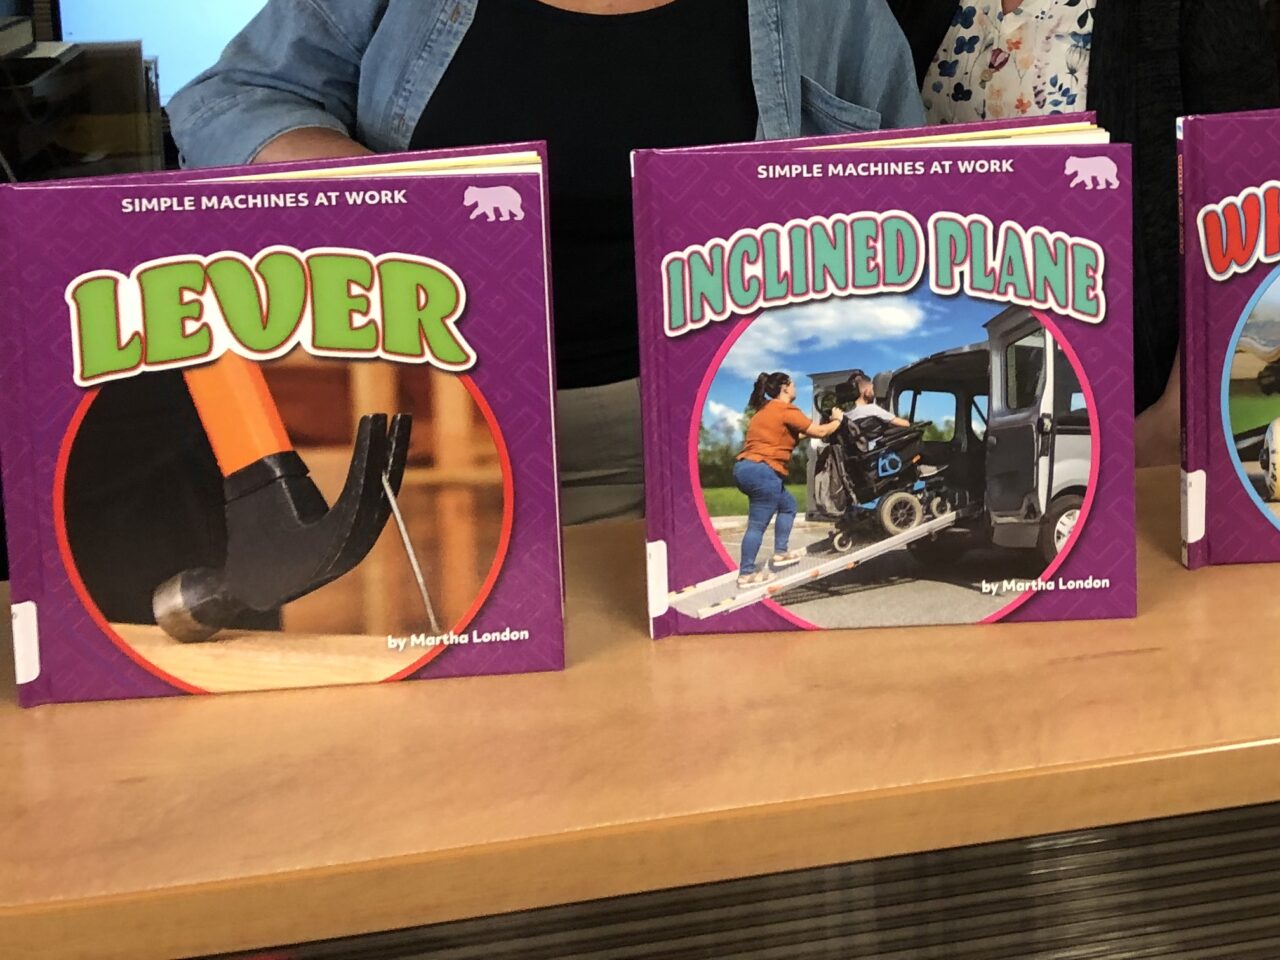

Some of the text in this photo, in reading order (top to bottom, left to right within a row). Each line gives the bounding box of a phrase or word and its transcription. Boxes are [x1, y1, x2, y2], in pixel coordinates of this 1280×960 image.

[757, 159, 1014, 179] SIMPLE MACHINES AT WORK
[121, 189, 408, 214] SIMPLE MACHINES AT WORK
[661, 210, 1107, 337] INCLINED PLANE
[66, 245, 476, 387] LEVER
[981, 576, 1110, 595] by Martha London
[387, 627, 529, 651] by Martha London
